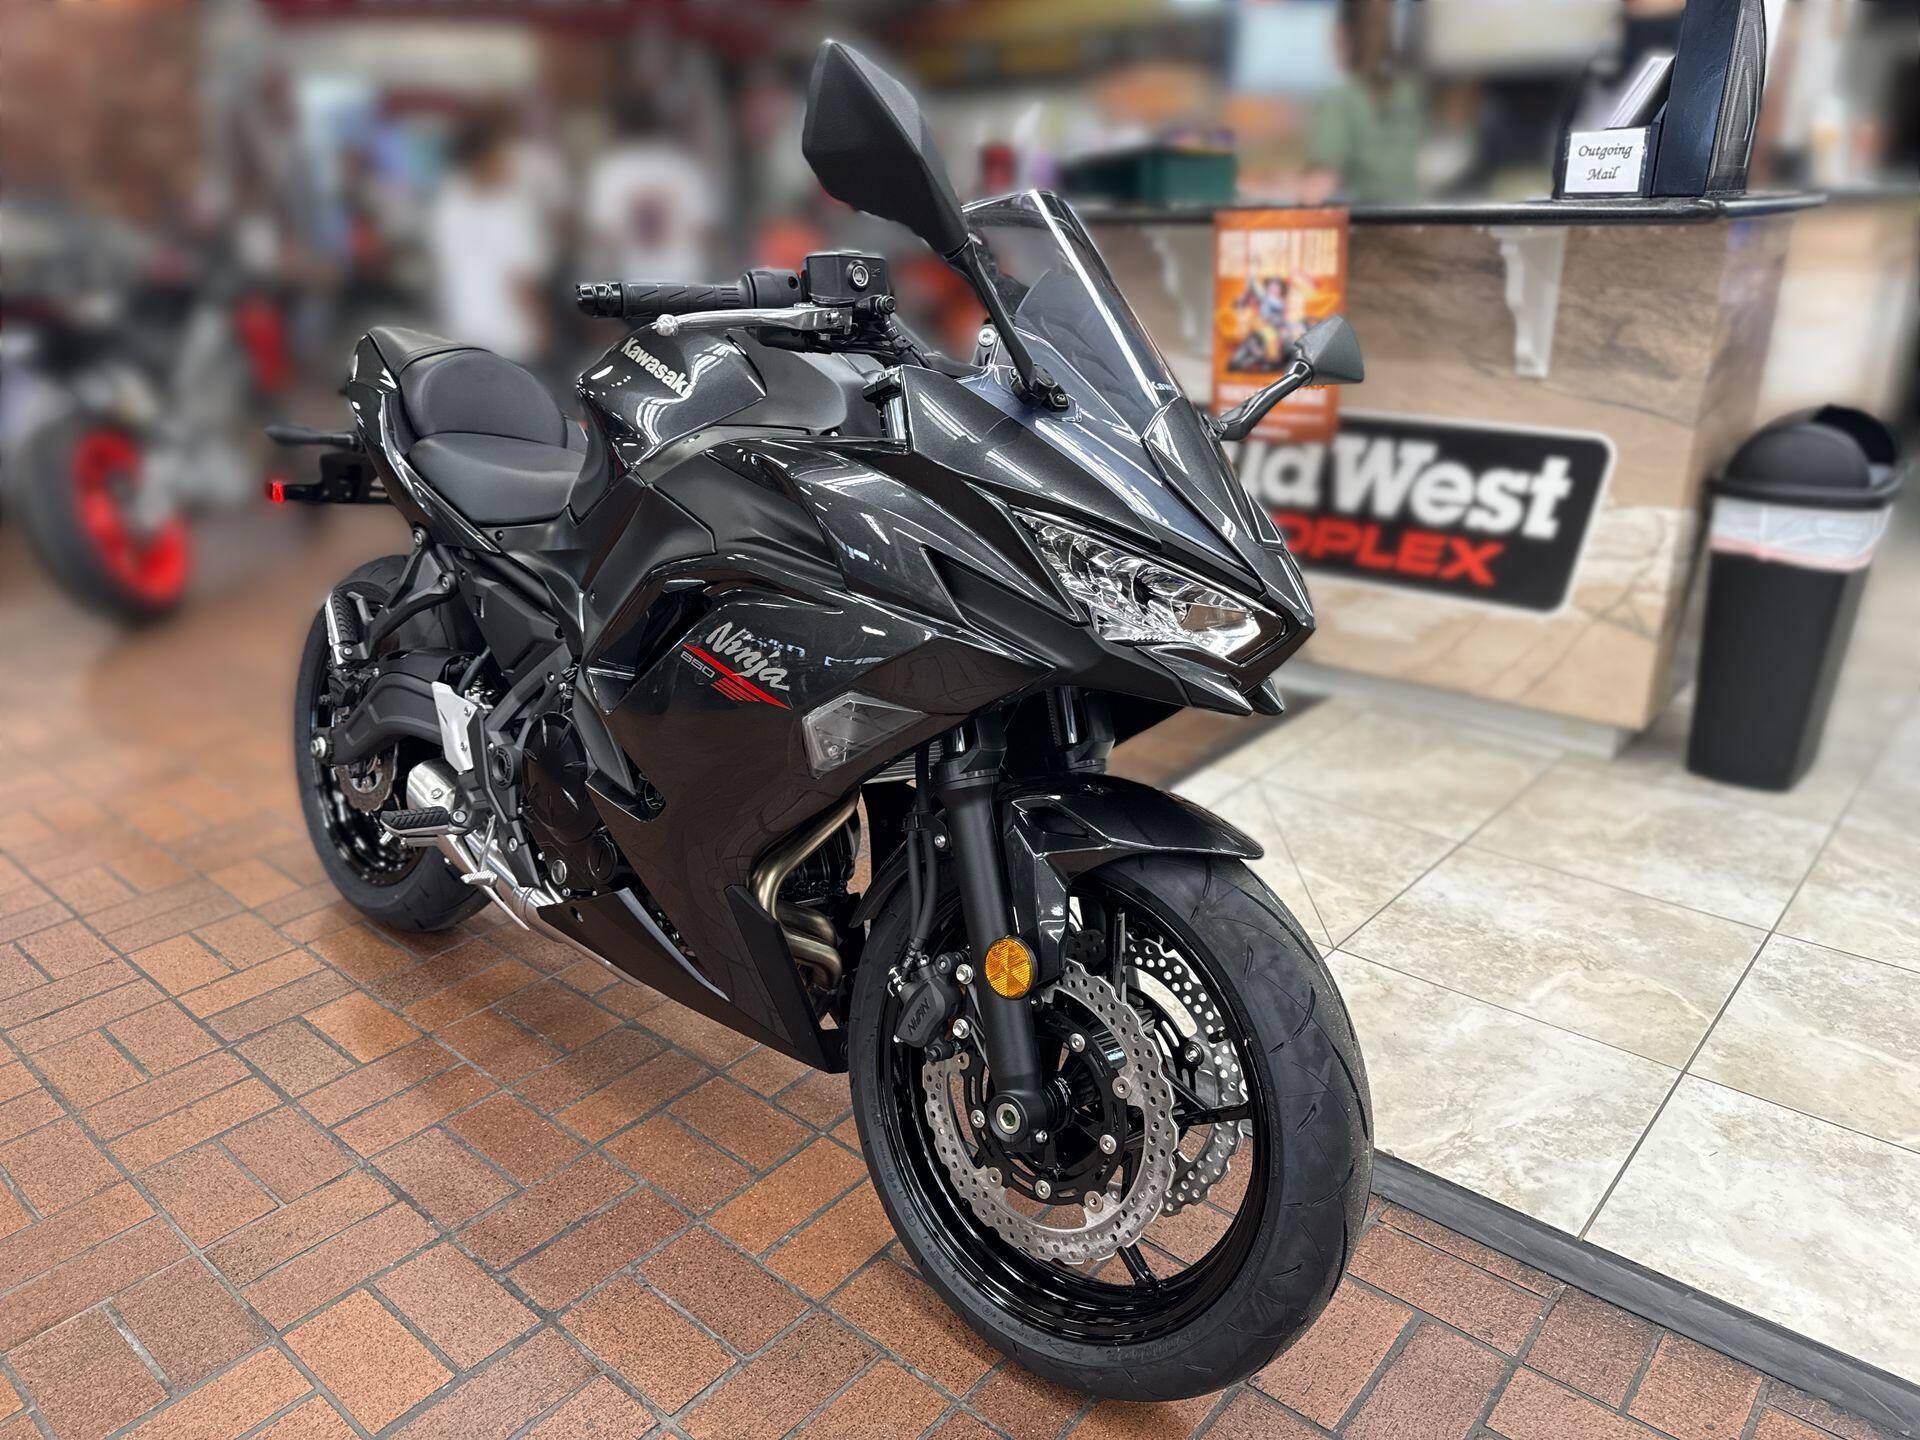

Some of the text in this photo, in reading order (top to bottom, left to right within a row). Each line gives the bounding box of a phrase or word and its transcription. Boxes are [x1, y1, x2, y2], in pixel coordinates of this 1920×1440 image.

[1578, 143, 1633, 160] Outgoing
[1586, 166, 1621, 181] Mail
[620, 337, 697, 399] Kawasaki
[1332, 434, 1574, 540] West
[1272, 513, 1504, 588] OPLEX
[680, 650, 716, 679] 650
[705, 621, 790, 692] Ninja
